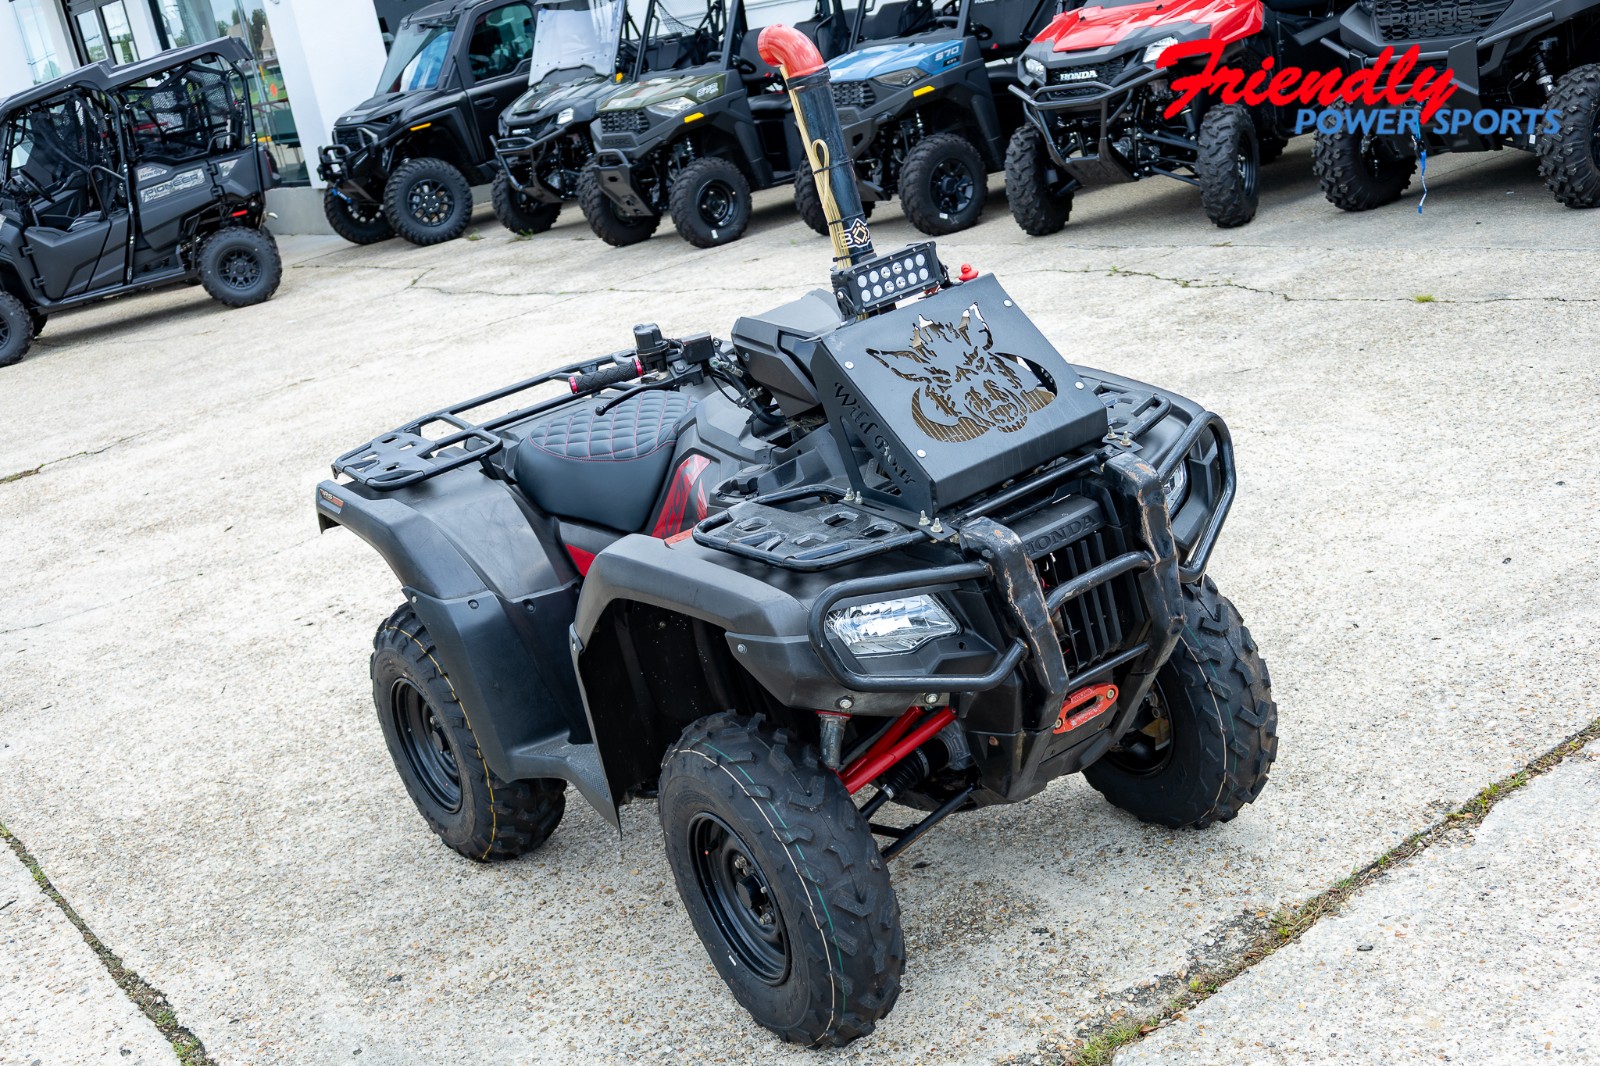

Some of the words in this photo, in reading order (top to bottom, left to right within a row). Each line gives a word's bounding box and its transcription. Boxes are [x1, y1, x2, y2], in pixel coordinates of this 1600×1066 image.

[1390, 5, 1474, 27] POLARIS
[935, 46, 960, 61] 570
[1059, 70, 1098, 82] HONDA
[144, 172, 199, 197] PIONEER
[834, 382, 879, 435] Wild
[874, 435, 917, 485] Boar
[1024, 514, 1099, 556] HONDA
